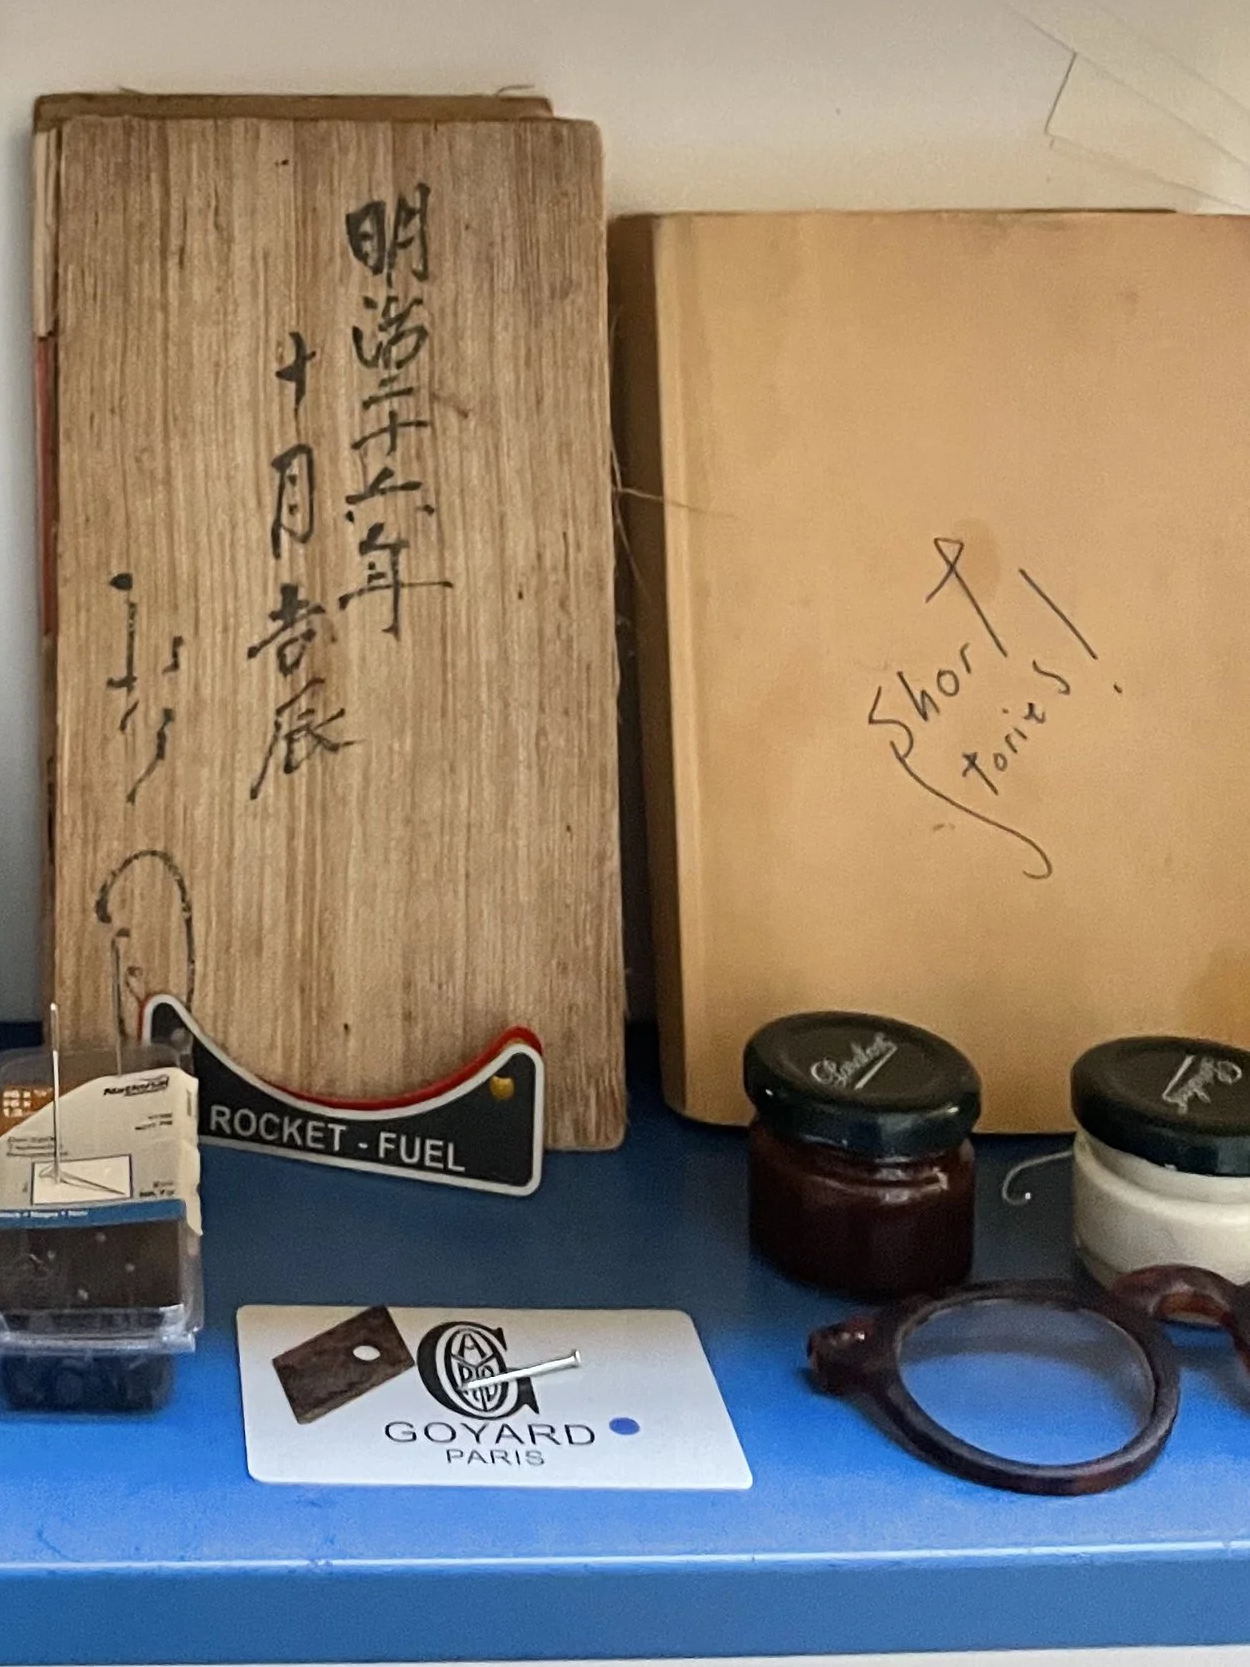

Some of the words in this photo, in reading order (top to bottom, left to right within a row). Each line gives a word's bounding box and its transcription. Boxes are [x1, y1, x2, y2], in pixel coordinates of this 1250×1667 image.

[209, 1104, 347, 1153] ROCKET
[378, 1131, 466, 1173] FUEL
[384, 1419, 597, 1448] GOYARD
[446, 1449, 546, 1467] PARIS
